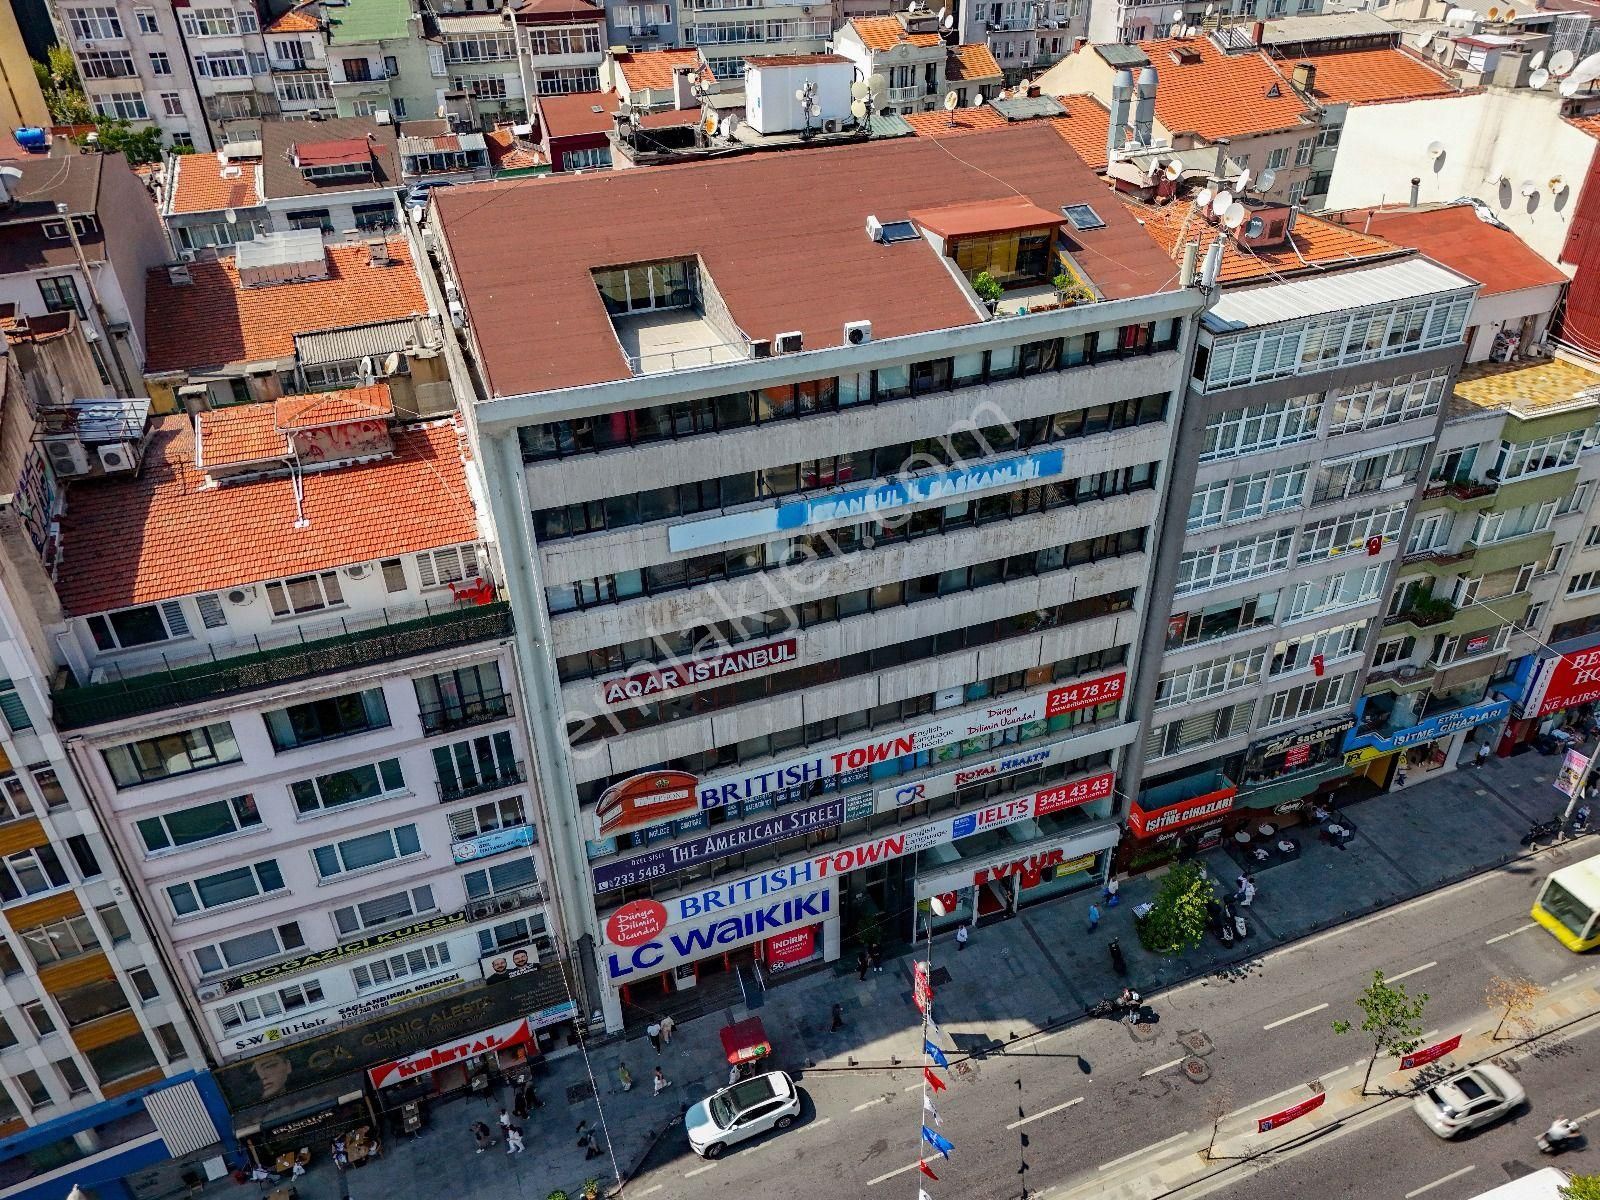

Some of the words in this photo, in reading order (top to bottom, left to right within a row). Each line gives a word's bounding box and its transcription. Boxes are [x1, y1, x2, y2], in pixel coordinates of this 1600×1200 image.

[607, 670, 679, 703] AQAR
[689, 644, 796, 683] ISTANBUL
[1571, 650, 1600, 670] BE
[1051, 689, 1078, 706] 234
[1082, 685, 1099, 698] 78
[1103, 678, 1121, 692] 78
[1542, 701, 1559, 712] NE
[912, 738, 944, 750] Schools
[913, 725, 942, 738] English
[701, 758, 822, 810] BRITISH
[831, 733, 914, 773] TOWN
[955, 765, 997, 785] ROYAL
[1000, 751, 1050, 770] HEALTH
[1040, 791, 1066, 807] 343
[1070, 784, 1088, 797] 43
[1091, 778, 1109, 792] 43
[978, 799, 1029, 825] IELTS
[670, 845, 699, 863] THE
[704, 820, 783, 854] AMERICAN
[790, 803, 842, 829] STREET
[905, 840, 937, 852] Schools
[906, 826, 936, 839] English
[614, 872, 635, 887] 233
[638, 864, 666, 880] 5483
[680, 862, 812, 920] BRITISH
[815, 834, 906, 877] TOWN
[378, 913, 464, 943] KURSU
[619, 917, 656, 933] Dilimin
[608, 942, 664, 979] LC
[361, 1017, 425, 1046] CLINIC
